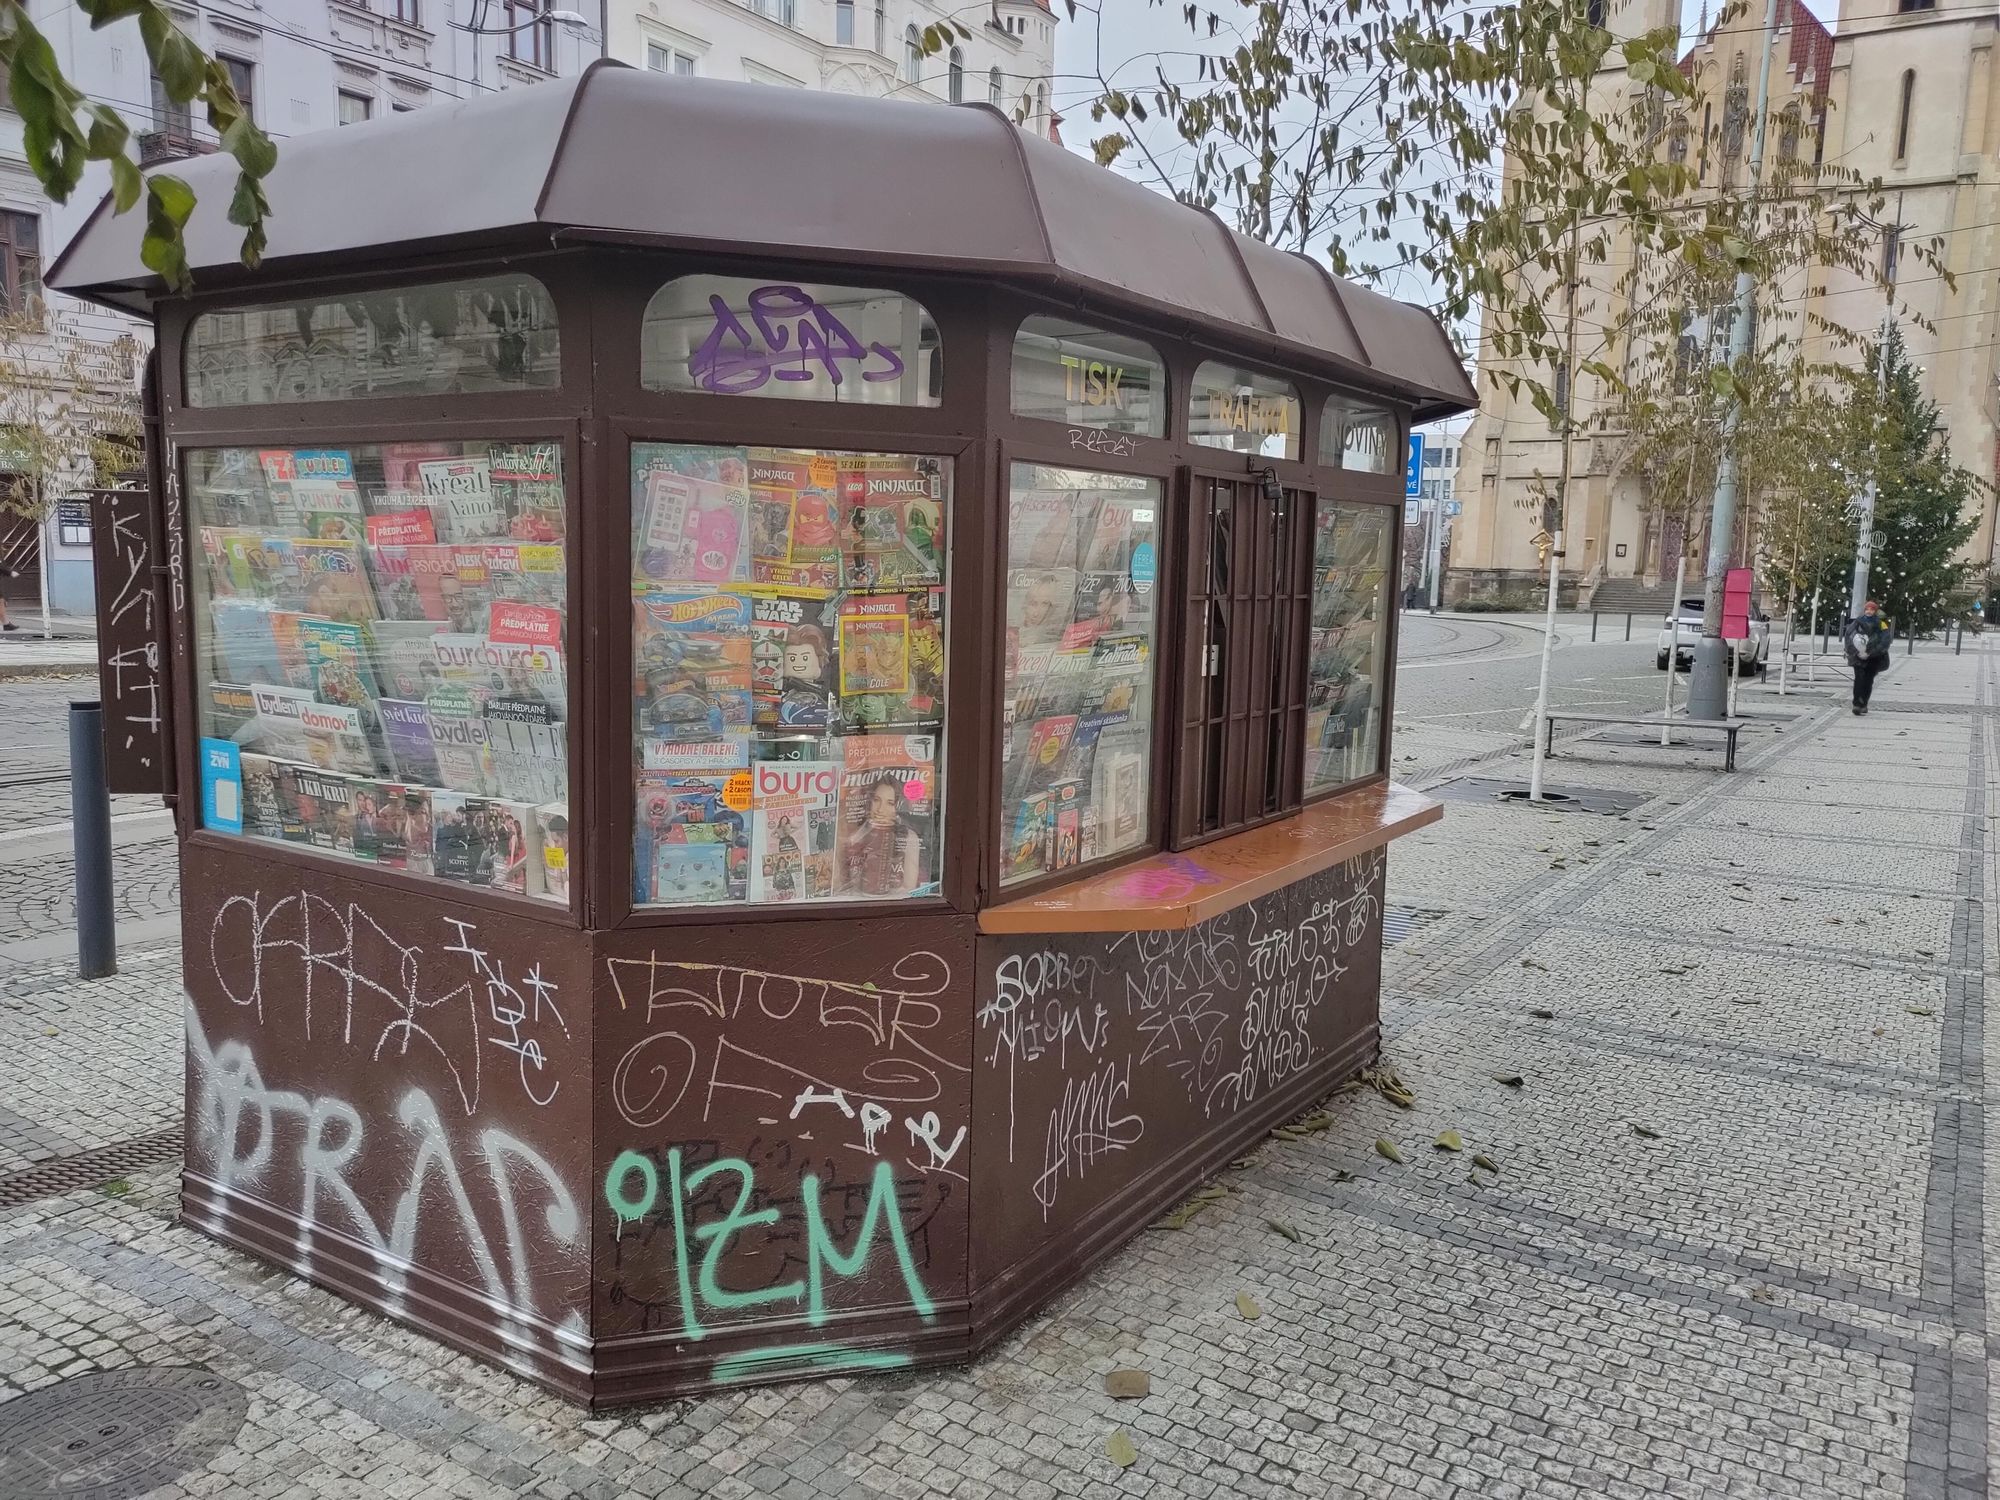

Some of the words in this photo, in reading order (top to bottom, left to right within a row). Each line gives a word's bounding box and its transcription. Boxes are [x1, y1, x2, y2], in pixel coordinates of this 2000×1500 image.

[1061, 354, 1123, 410] TISK
[1206, 388, 1290, 438] TRAFIKA
[1330, 414, 1387, 458] NOVINY
[752, 468, 797, 484] NINJAGO
[867, 479, 929, 496] NINJAGO
[378, 524, 422, 537] PŘEDPLATNÉ
[455, 553, 482, 567] BLESK
[756, 599, 803, 612] STAR
[859, 604, 897, 615] NINJAGO
[755, 609, 803, 624] WARS
[500, 617, 549, 632] PŘEDPLATNÉ
[1097, 648, 1140, 665] Zahrada
[302, 707, 348, 731] domov
[1052, 722, 1073, 737] 2026
[210, 754, 230, 769] ZYN
[844, 766, 931, 787] marianne
